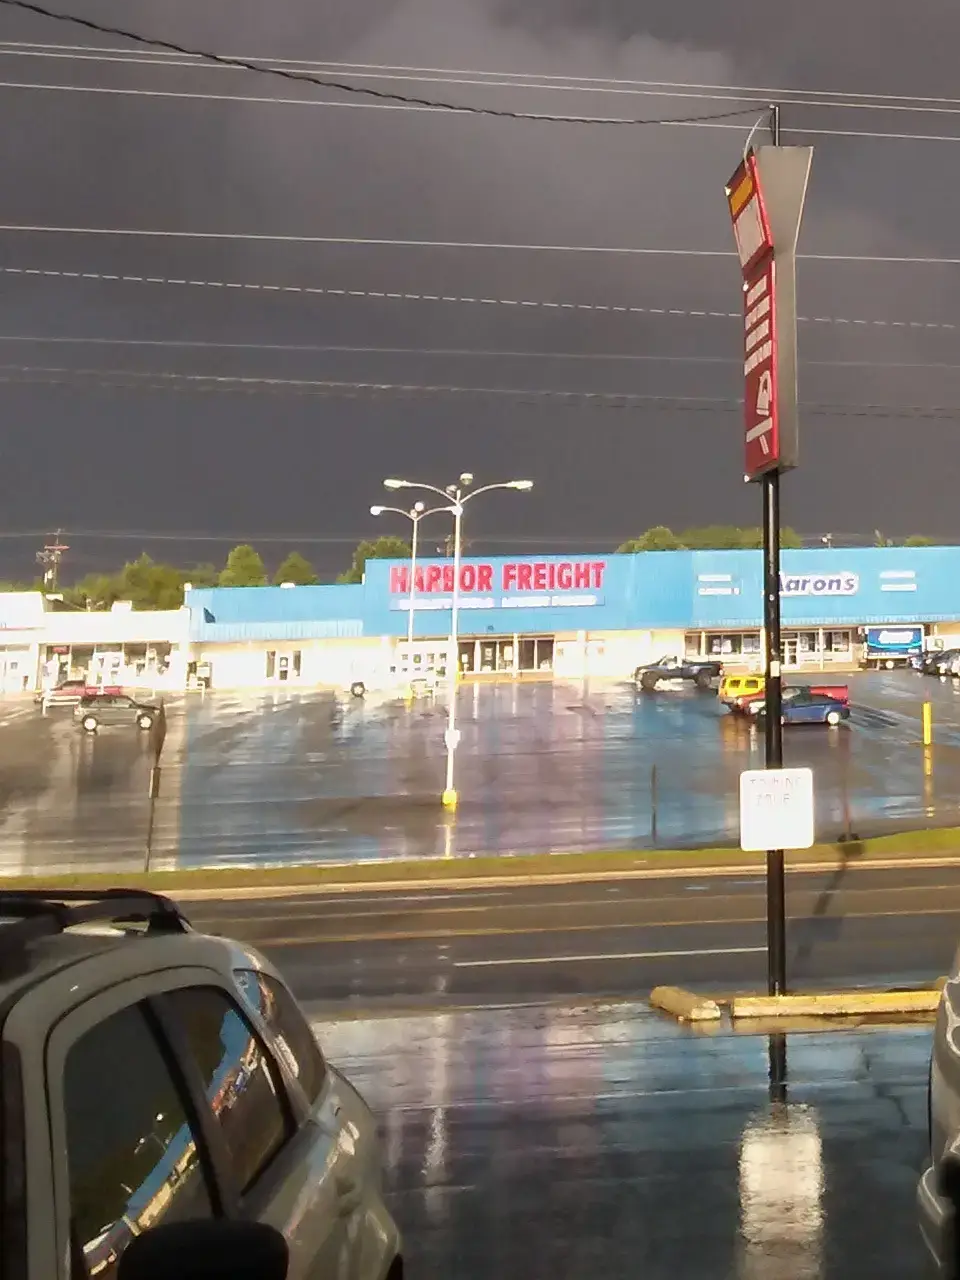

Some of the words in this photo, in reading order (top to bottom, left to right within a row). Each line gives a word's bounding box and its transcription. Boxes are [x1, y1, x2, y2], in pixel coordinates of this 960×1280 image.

[389, 564, 493, 593] HARBOR
[502, 562, 606, 591] FREIGHT
[779, 575, 855, 592] arons
